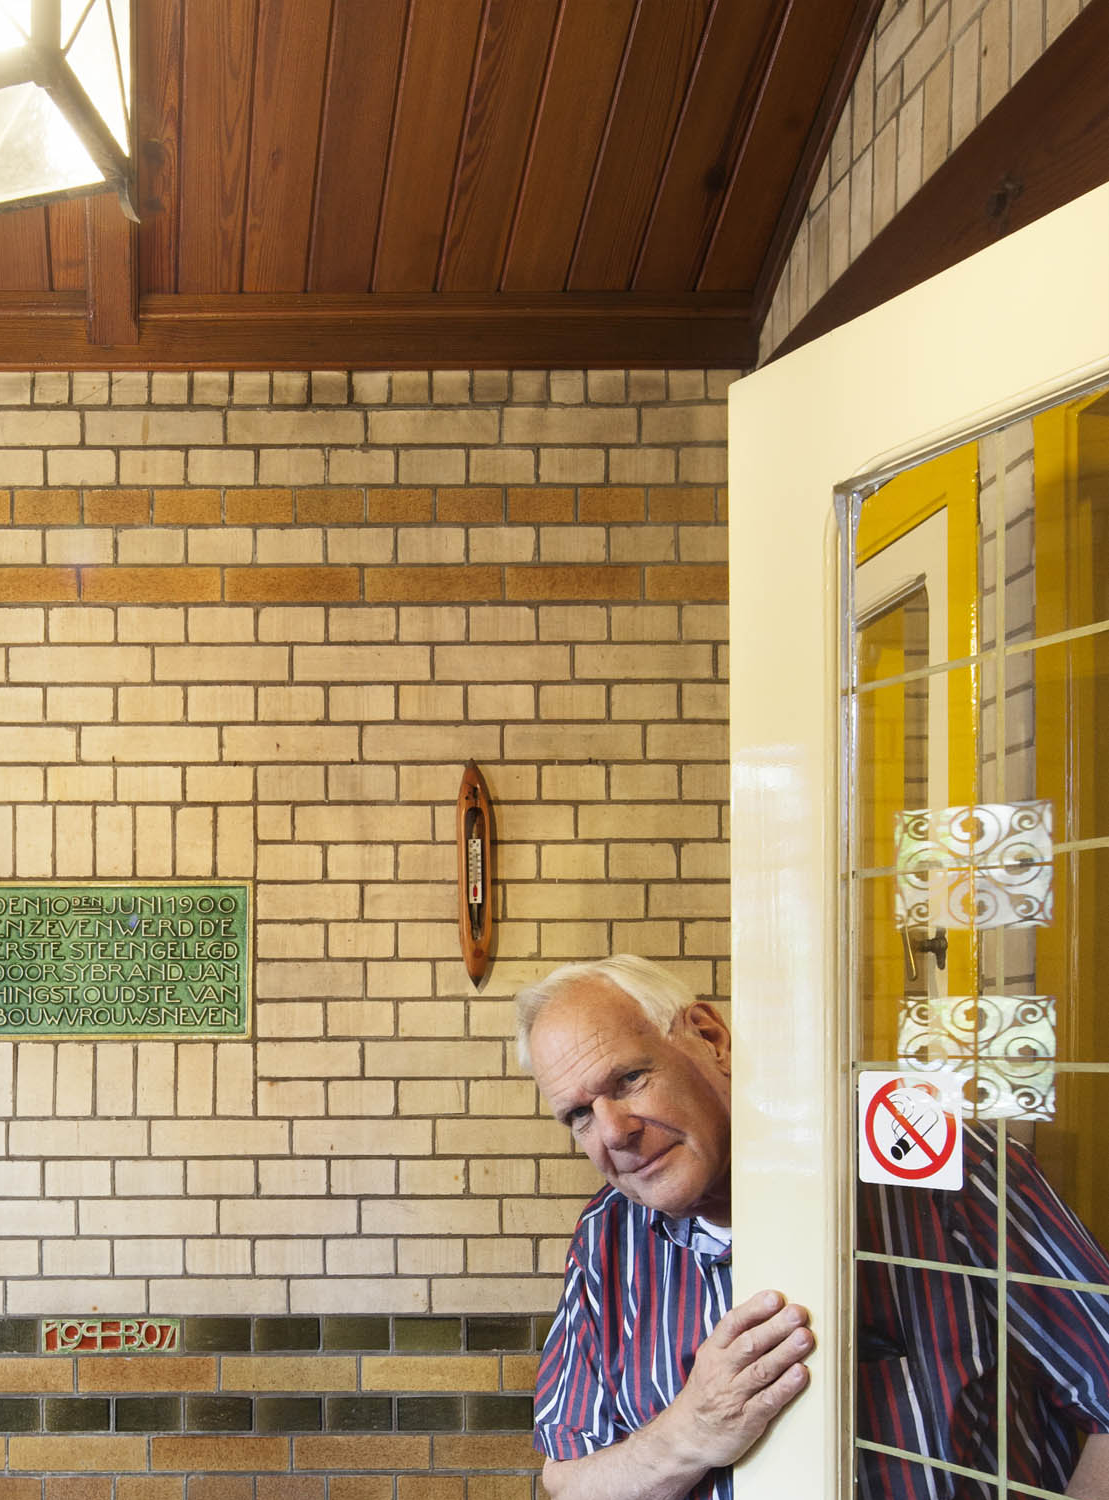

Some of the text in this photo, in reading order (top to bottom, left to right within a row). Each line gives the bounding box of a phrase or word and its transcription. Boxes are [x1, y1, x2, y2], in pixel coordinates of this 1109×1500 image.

[103, 896, 162, 916] JUNI
[164, 895, 237, 916] 1900
[27, 918, 113, 938] ZEVEN
[116, 918, 194, 938] WERD
[69, 941, 149, 960] STEEN
[150, 941, 239, 960] GELEGD
[188, 963, 239, 982] JAN
[82, 985, 181, 1005] OUDSTE
[187, 985, 239, 1005] VAN
